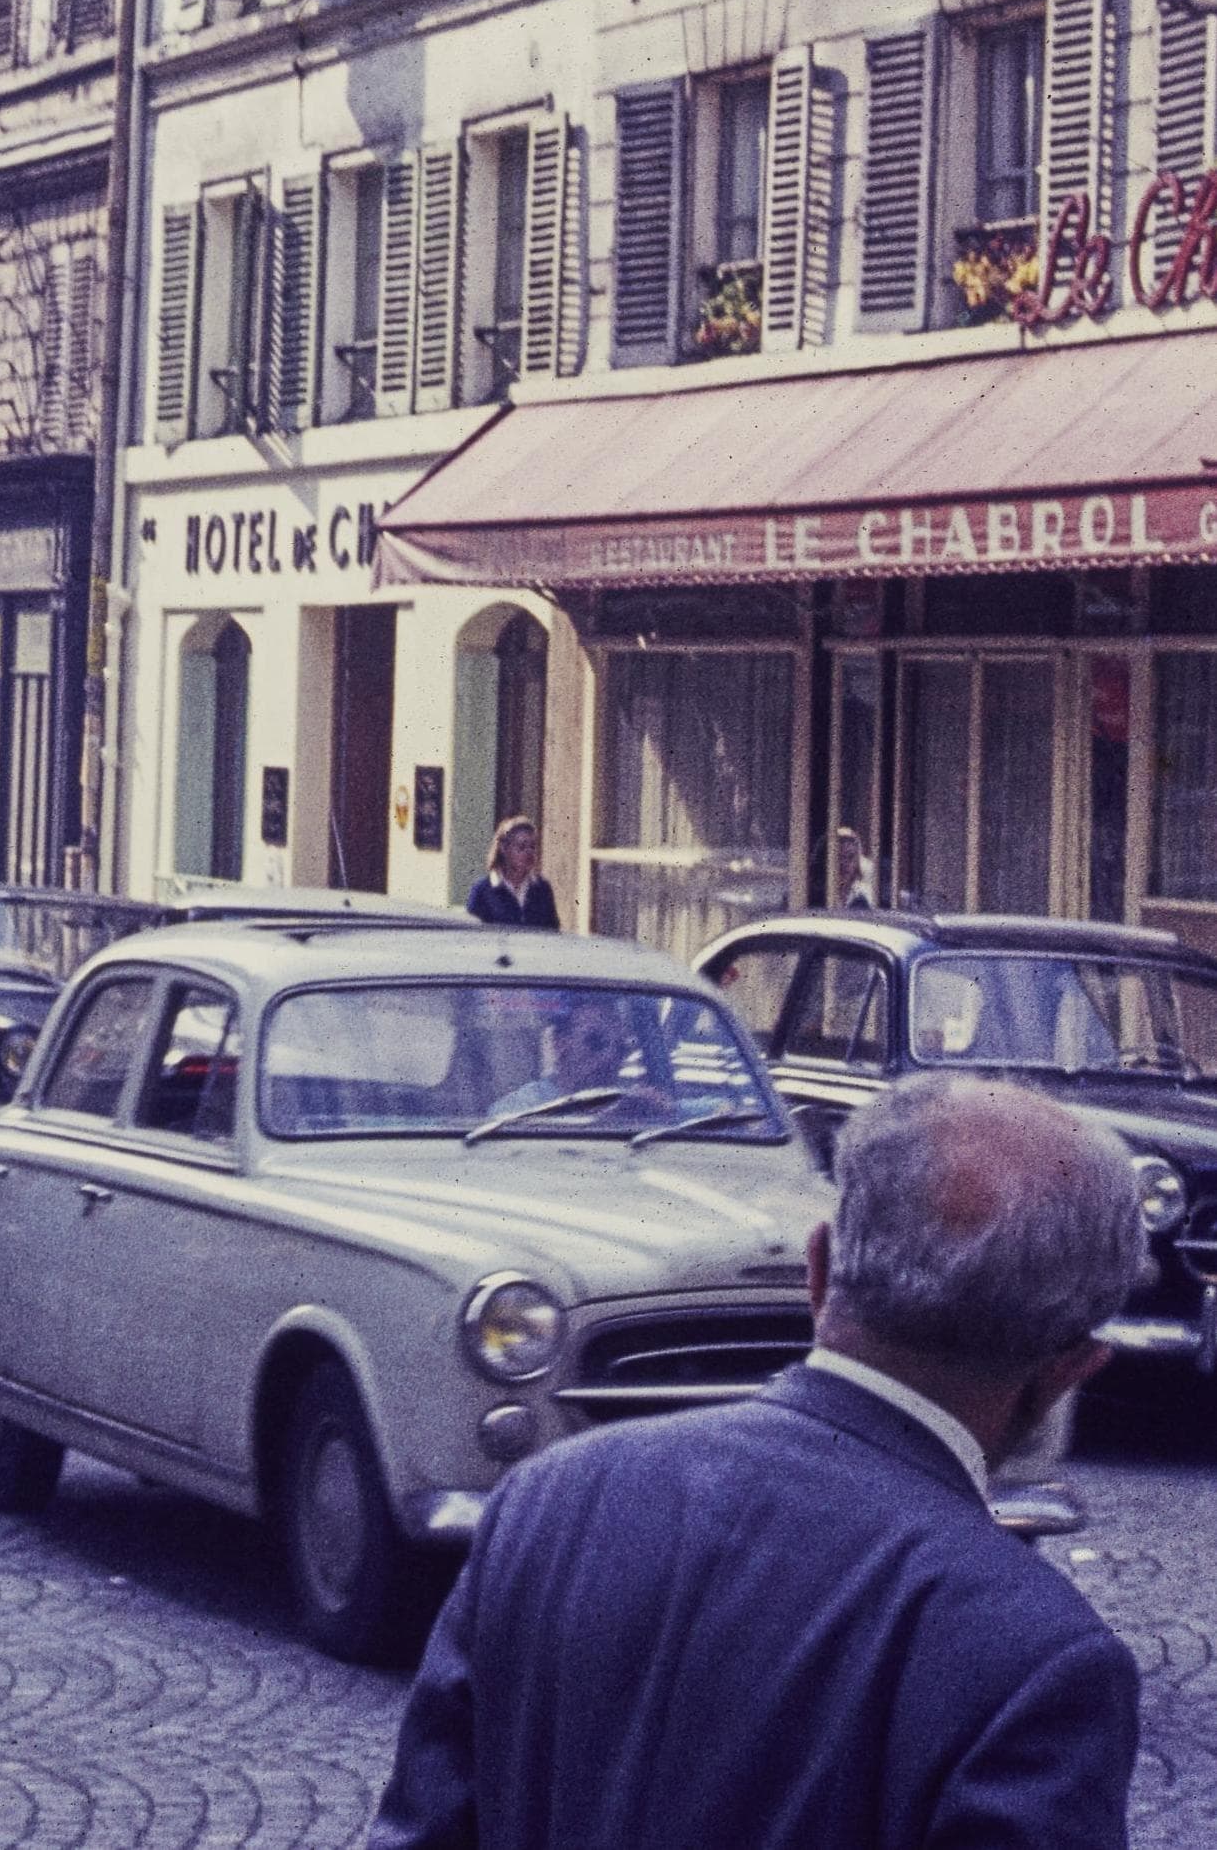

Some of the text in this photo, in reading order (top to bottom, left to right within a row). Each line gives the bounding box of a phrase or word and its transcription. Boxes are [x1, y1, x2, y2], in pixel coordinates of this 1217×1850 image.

[1012, 191, 1112, 323] Le
[185, 508, 281, 575] HOTEL
[328, 502, 393, 570] CH
[763, 515, 822, 569] LE
[856, 495, 1166, 566] CHABROL
